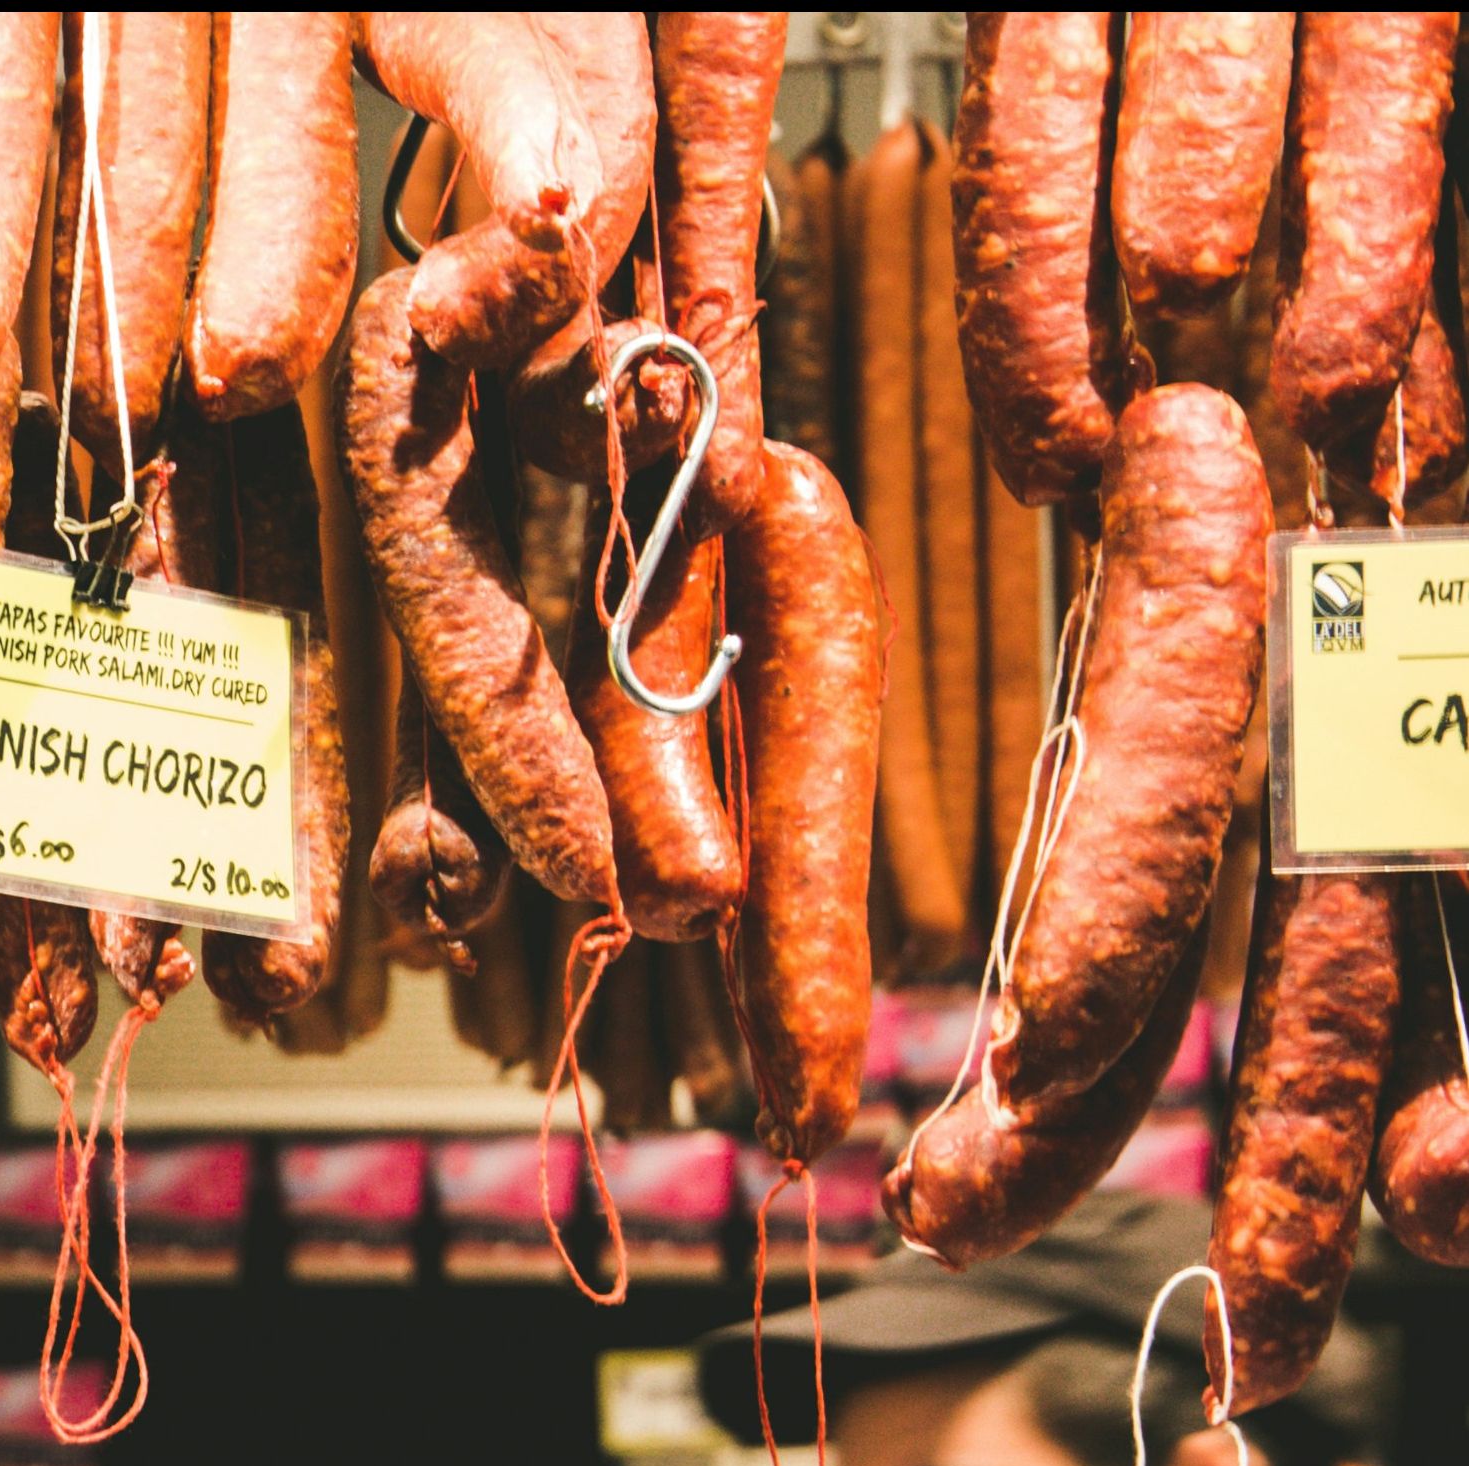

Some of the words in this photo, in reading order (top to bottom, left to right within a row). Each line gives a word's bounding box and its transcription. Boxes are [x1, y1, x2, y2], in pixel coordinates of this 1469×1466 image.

[53, 613, 150, 651] FAVOURITE
[181, 638, 216, 665] YUM
[43, 644, 91, 675] PORK
[211, 677, 268, 706] CURED
[103, 740, 267, 808] CHORIZO
